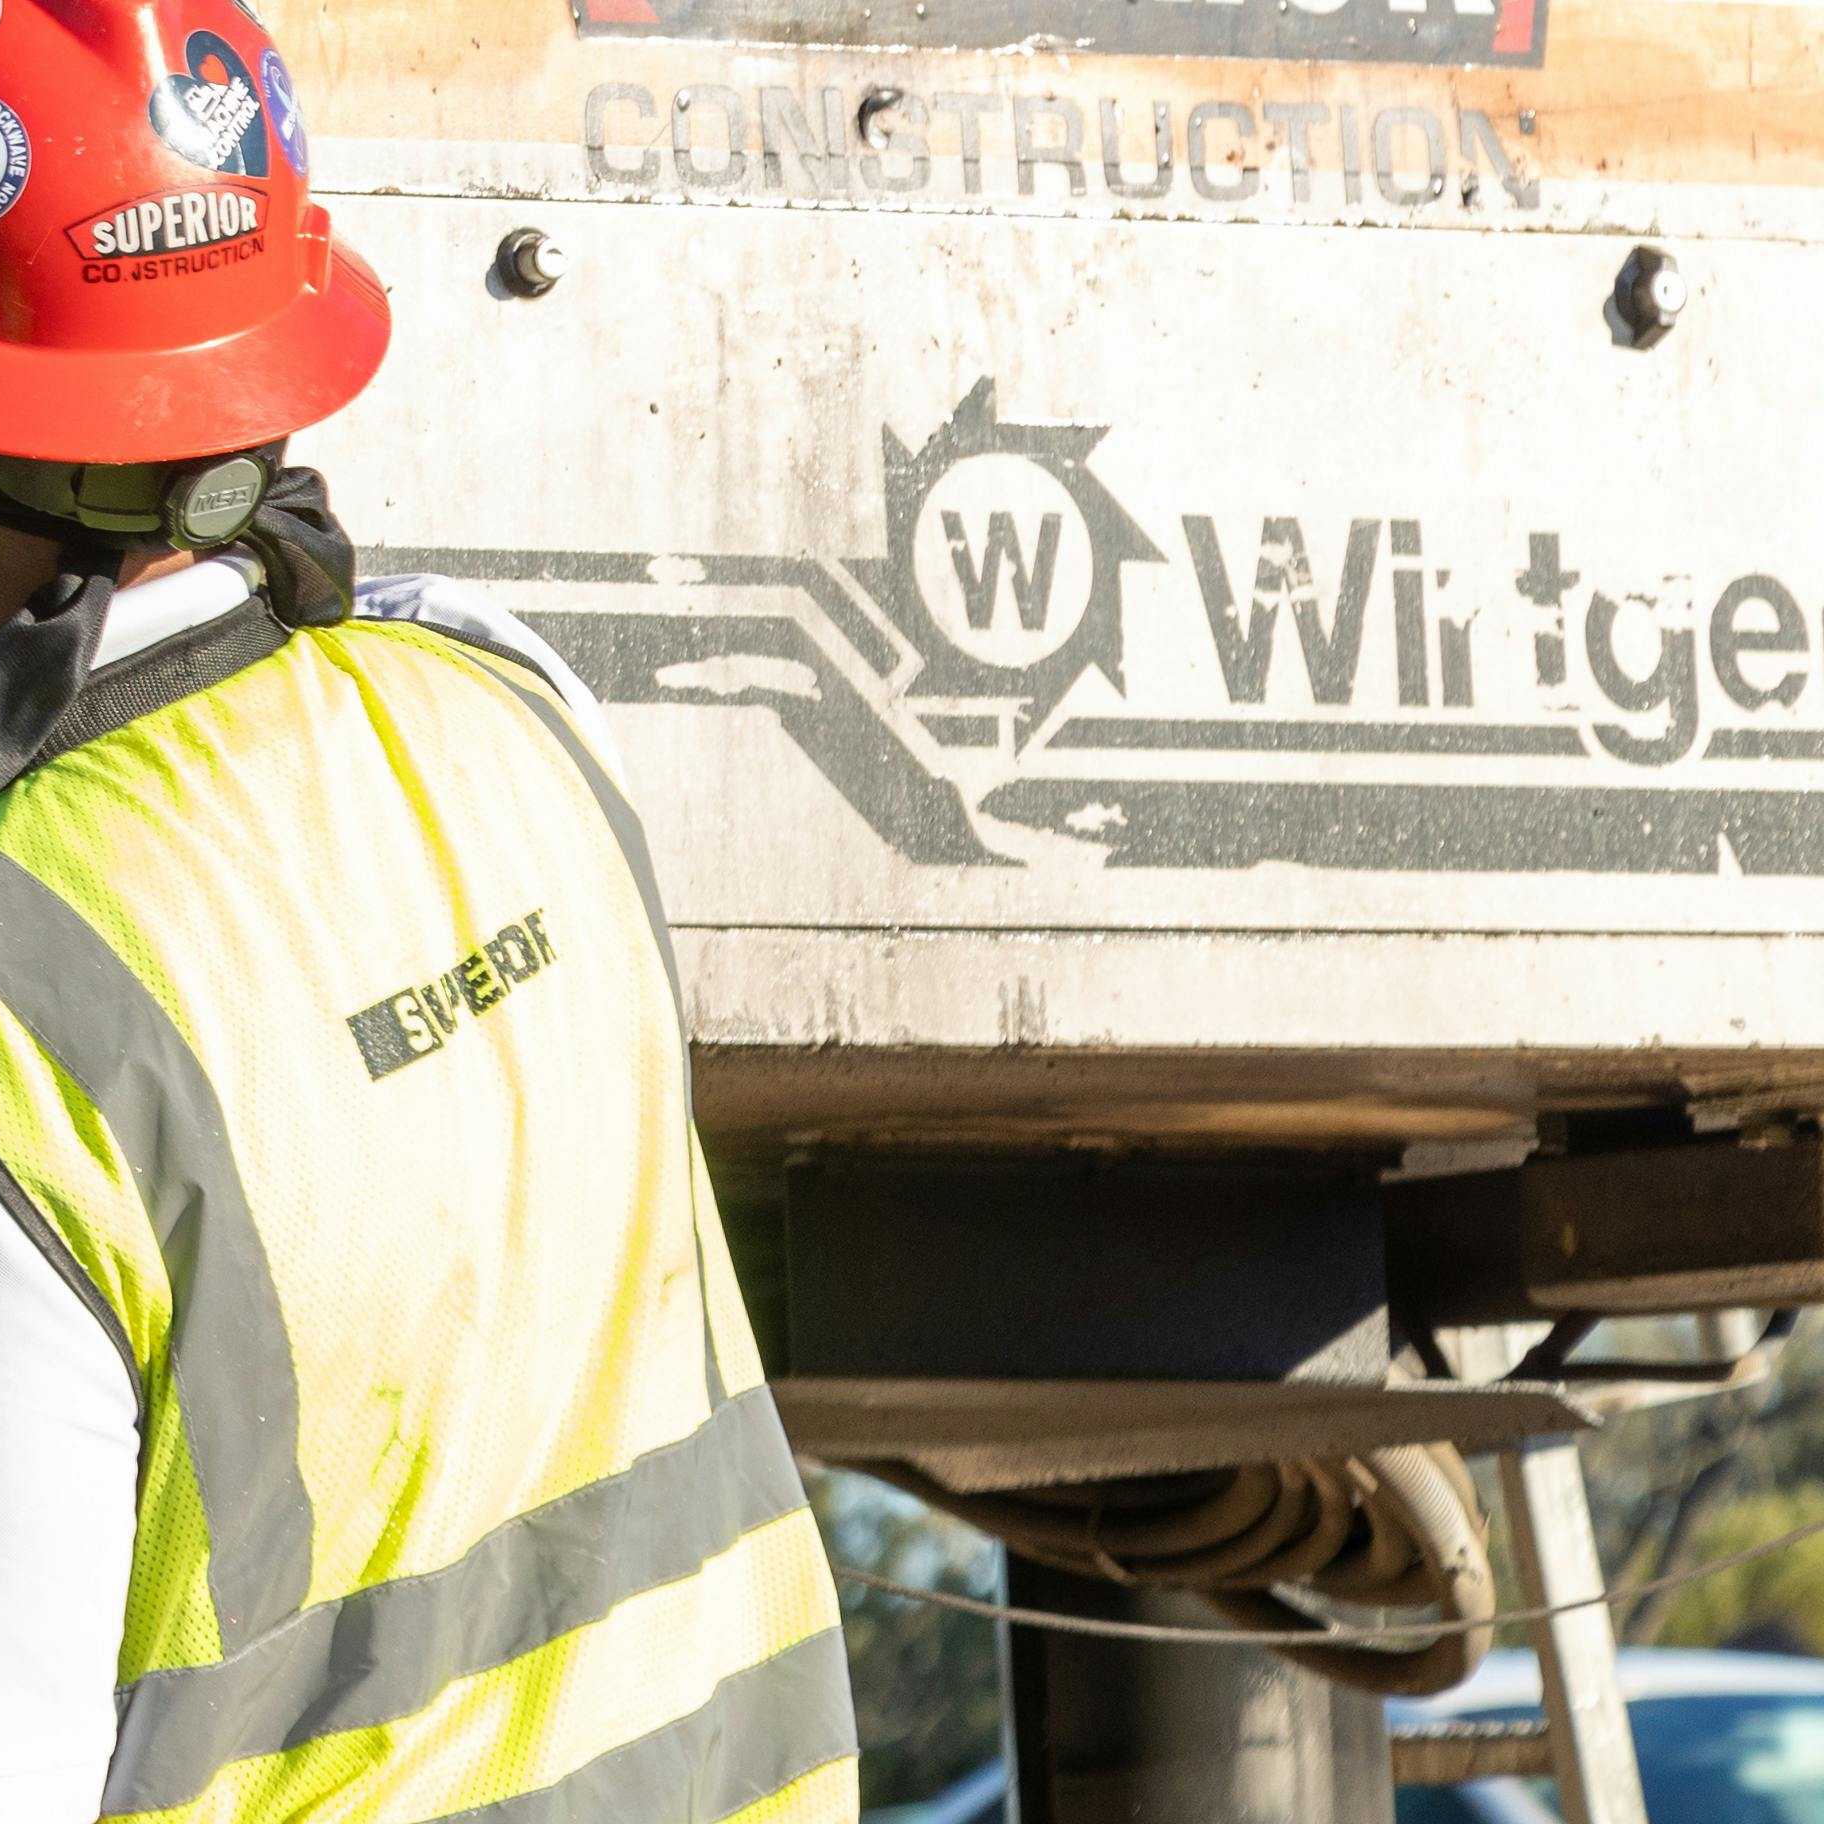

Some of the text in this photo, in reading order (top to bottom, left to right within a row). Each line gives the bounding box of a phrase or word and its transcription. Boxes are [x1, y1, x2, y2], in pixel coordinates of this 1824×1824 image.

[584, 81, 1542, 210] CONSTRUCTION
[91, 191, 258, 255] SUPERIOR
[940, 511, 1063, 631] W
[1180, 513, 1824, 768] Wirtge
